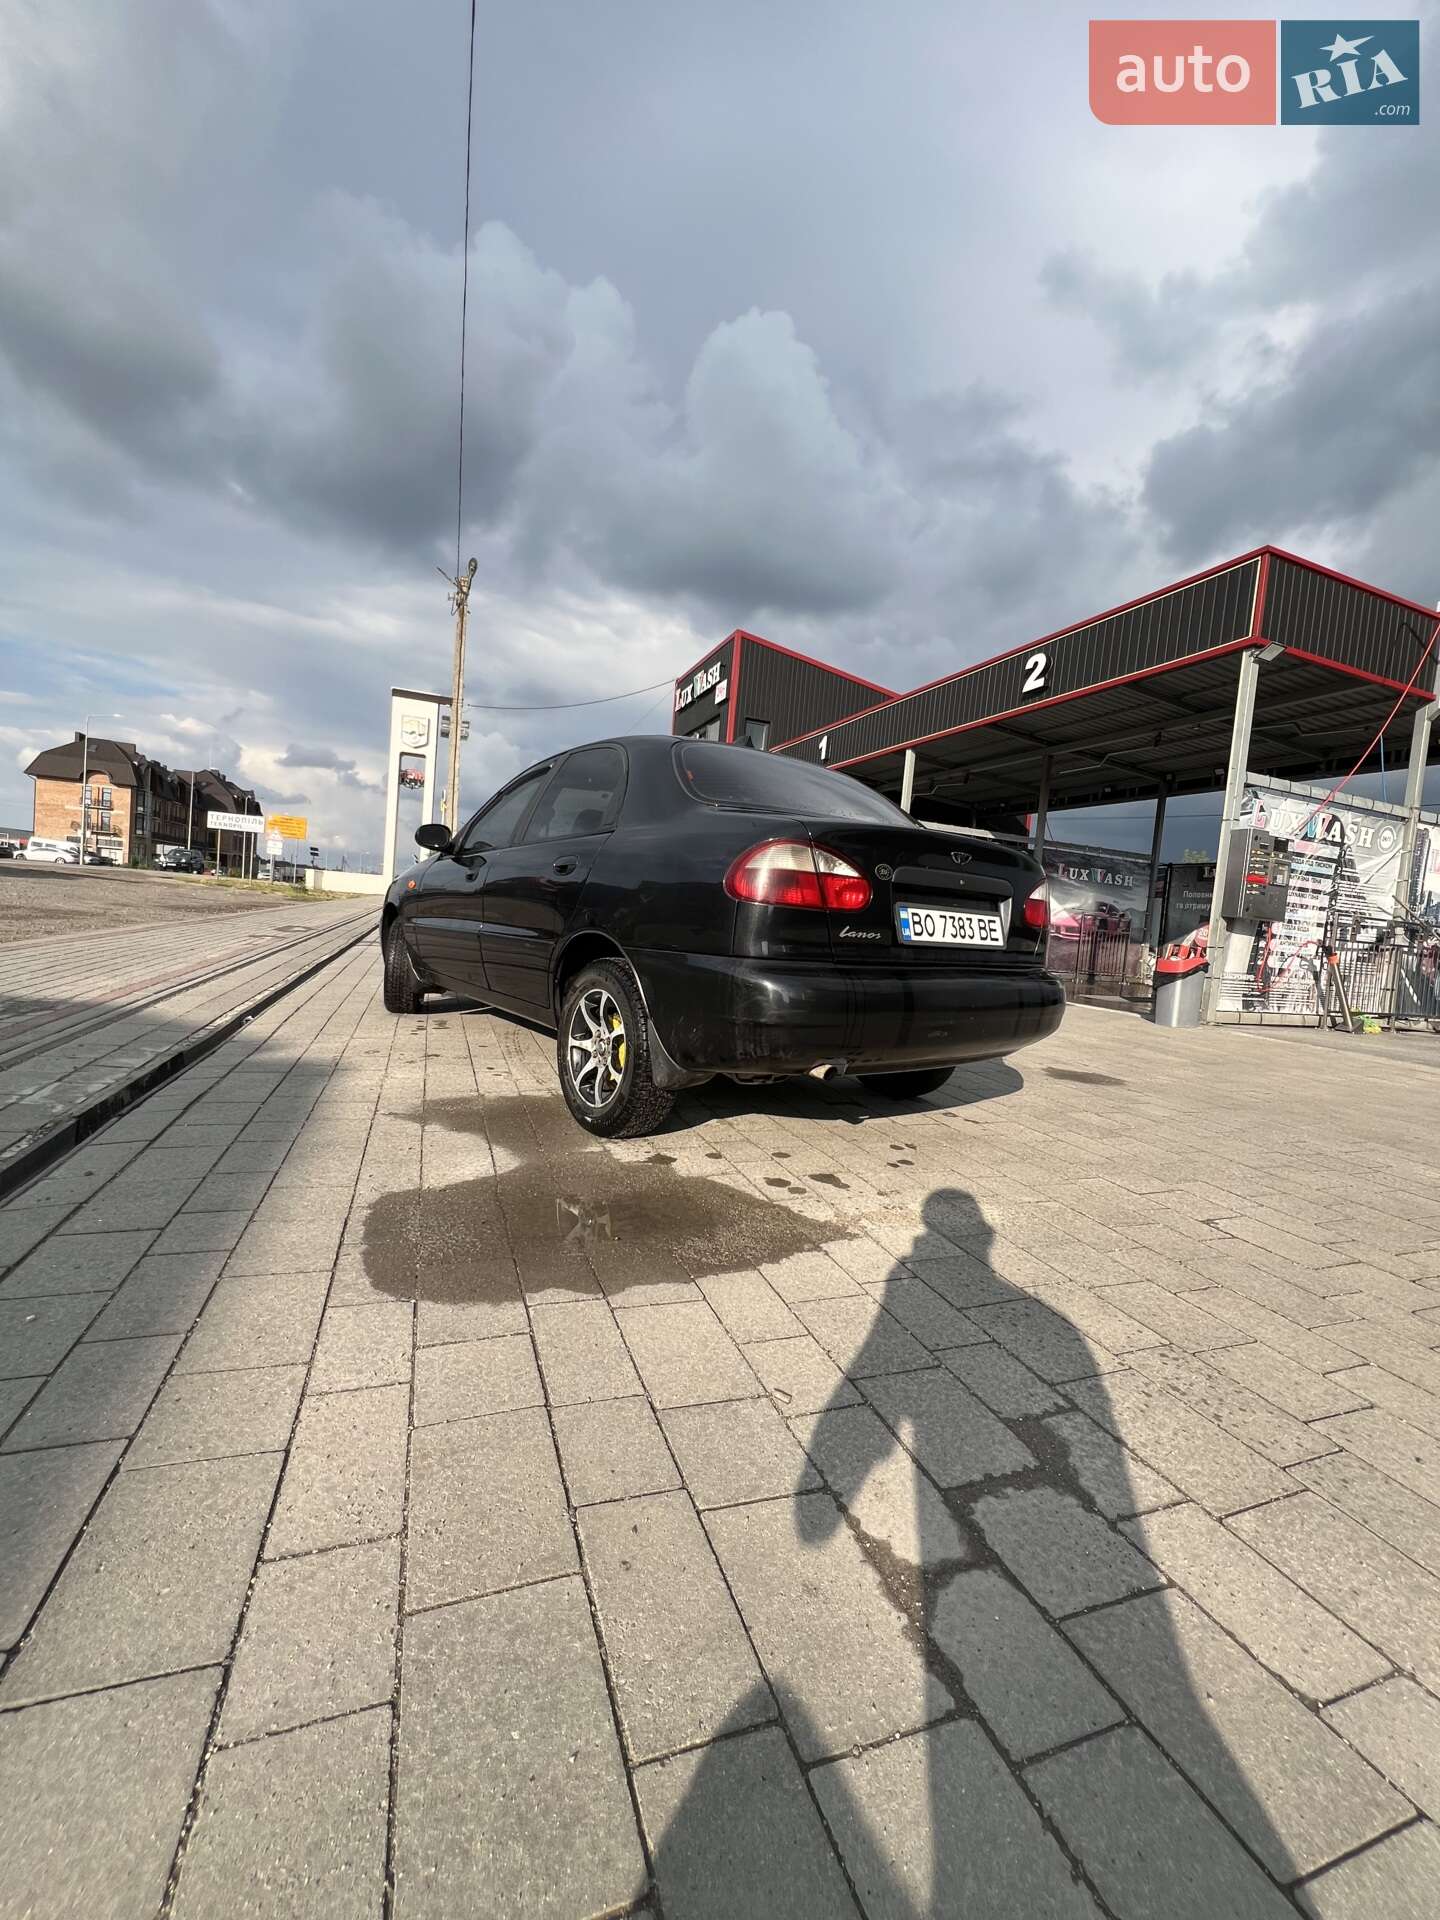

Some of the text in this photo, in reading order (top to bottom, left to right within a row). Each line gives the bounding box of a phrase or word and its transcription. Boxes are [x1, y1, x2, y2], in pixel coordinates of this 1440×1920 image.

[694, 661, 721, 698] WASH
[1022, 653, 1047, 693] 2
[818, 735, 829, 760] 1
[1057, 862, 1134, 887] LUX WASH
[911, 912, 999, 942] BO 7383 BE
